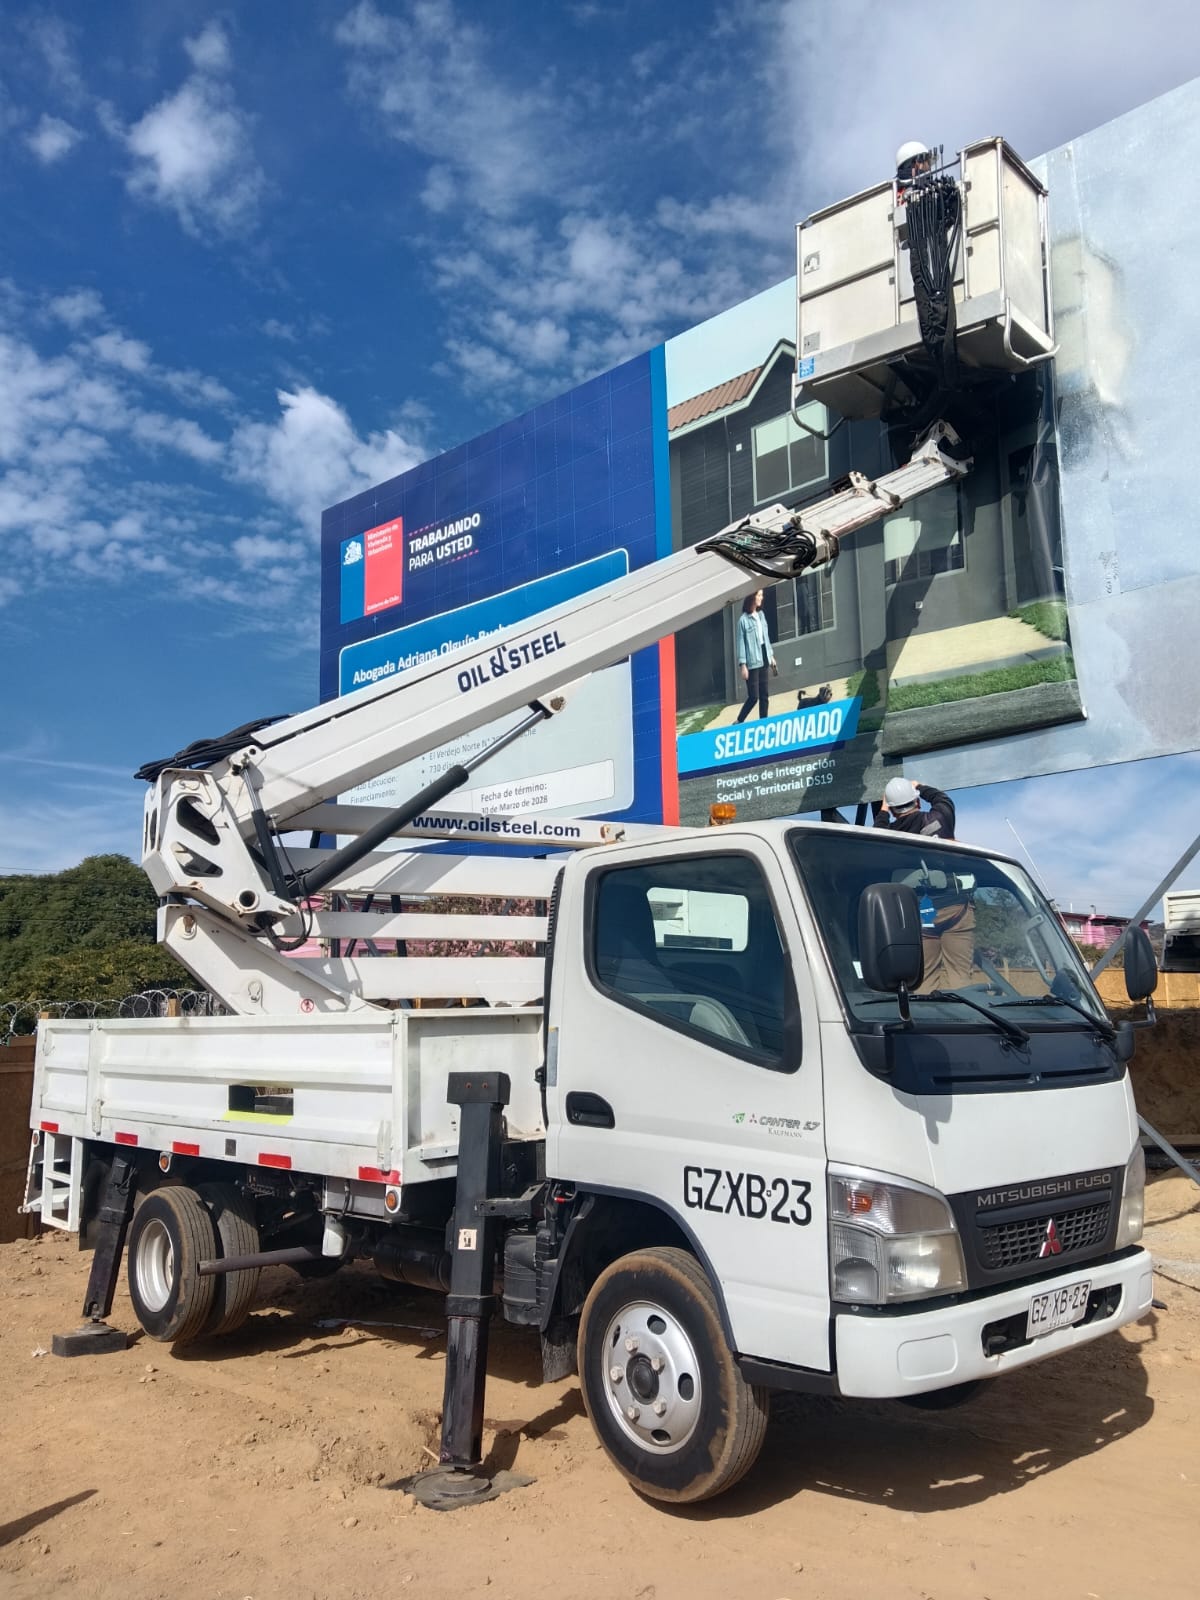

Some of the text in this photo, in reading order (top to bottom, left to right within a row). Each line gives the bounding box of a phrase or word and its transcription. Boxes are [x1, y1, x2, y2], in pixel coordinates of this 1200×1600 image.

[409, 513, 481, 554] TRABAJANDO
[409, 534, 473, 572] PARA USTED
[353, 659, 395, 685] Abogada
[398, 649, 438, 670] Adriana
[462, 742, 481, 753] Norte
[714, 708, 842, 760] SELECCIONADO
[716, 757, 836, 789] Proyecto de Integración
[716, 773, 834, 804] Social y Territorial DS19
[481, 782, 548, 803] Fecha de término:
[490, 804, 498, 814] de
[499, 799, 520, 811] Marzo
[522, 797, 530, 807] de
[412, 816, 581, 838] www.oilsteel.com
[760, 1115, 801, 1129] CANTER
[977, 1173, 1112, 1207] MITSUBISHI FUSO
